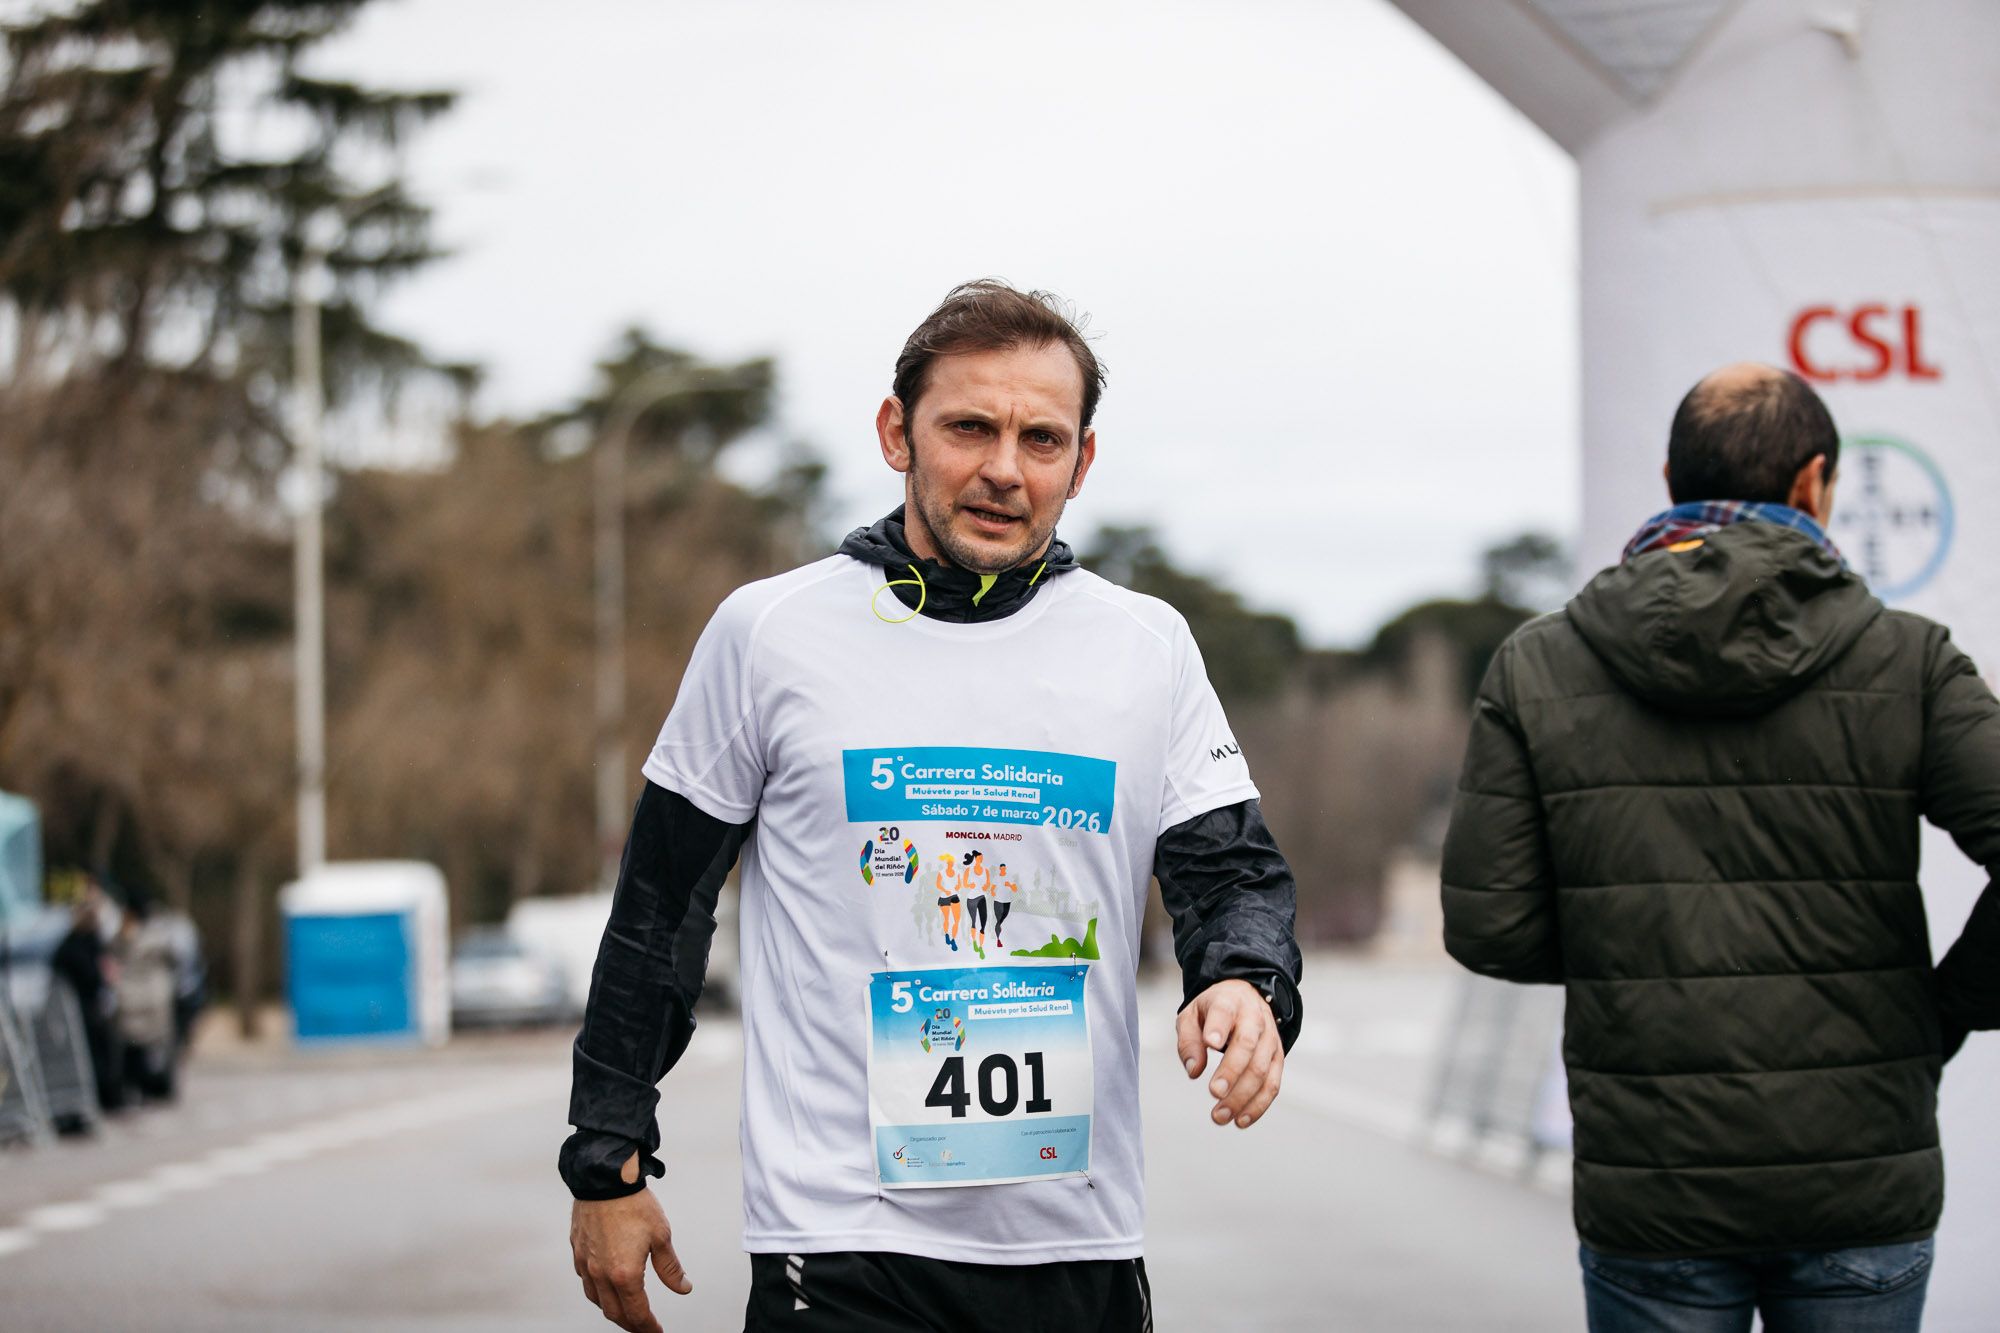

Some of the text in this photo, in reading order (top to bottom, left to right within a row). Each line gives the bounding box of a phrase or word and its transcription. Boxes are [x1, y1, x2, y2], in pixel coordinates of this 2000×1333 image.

[1788, 305, 1942, 384] CSL
[1210, 741, 1243, 762] MU
[901, 763, 975, 779] Carrera
[981, 764, 1063, 785] Solidaria
[912, 787, 951, 795] Muévete
[972, 788, 980, 796] la
[983, 788, 1009, 797] Salud
[1011, 789, 1036, 799] Renal
[921, 804, 1039, 820] Sábado 7 de marzo
[1042, 806, 1101, 833] 2026
[879, 827, 899, 841] 20
[945, 832, 1022, 841] MONCLOA MADRID
[919, 986, 988, 1002] Carrera
[992, 981, 1055, 999] Solidaria
[1020, 1005, 1027, 1013] la
[1029, 1004, 1048, 1012] Salud
[1049, 1003, 1069, 1011] Renal
[925, 1052, 1052, 1118] 401
[1040, 1147, 1057, 1159] CSL
